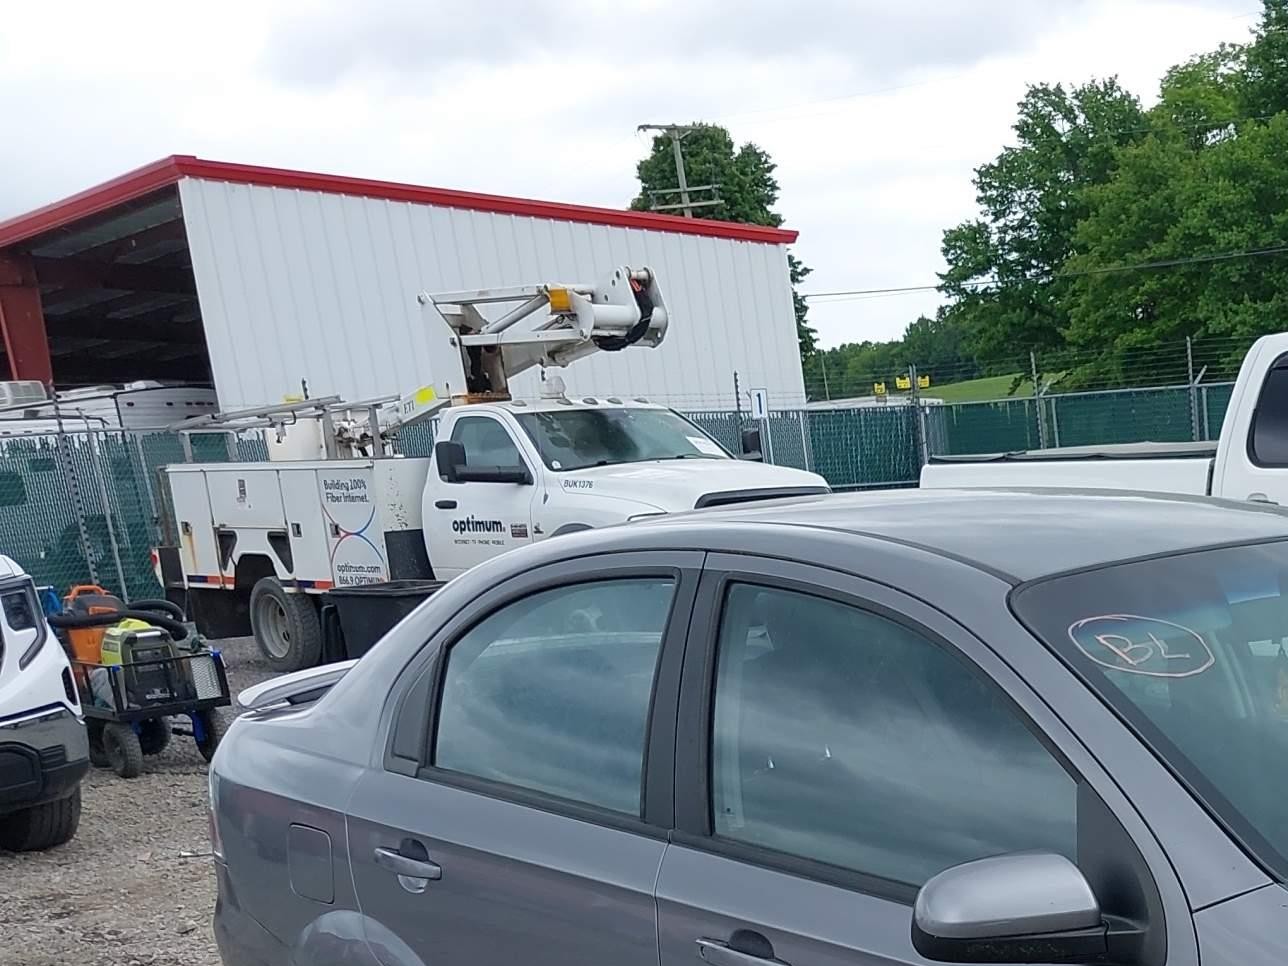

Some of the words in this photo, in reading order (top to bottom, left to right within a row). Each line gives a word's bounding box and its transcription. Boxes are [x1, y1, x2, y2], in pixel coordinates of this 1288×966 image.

[755, 392, 763, 415] 1
[324, 480, 349, 492] Building
[350, 480, 367, 490] 100%
[326, 493, 342, 503] Fiber
[336, 561, 381, 575] optimum.com
[1094, 631, 1191, 666] BL
